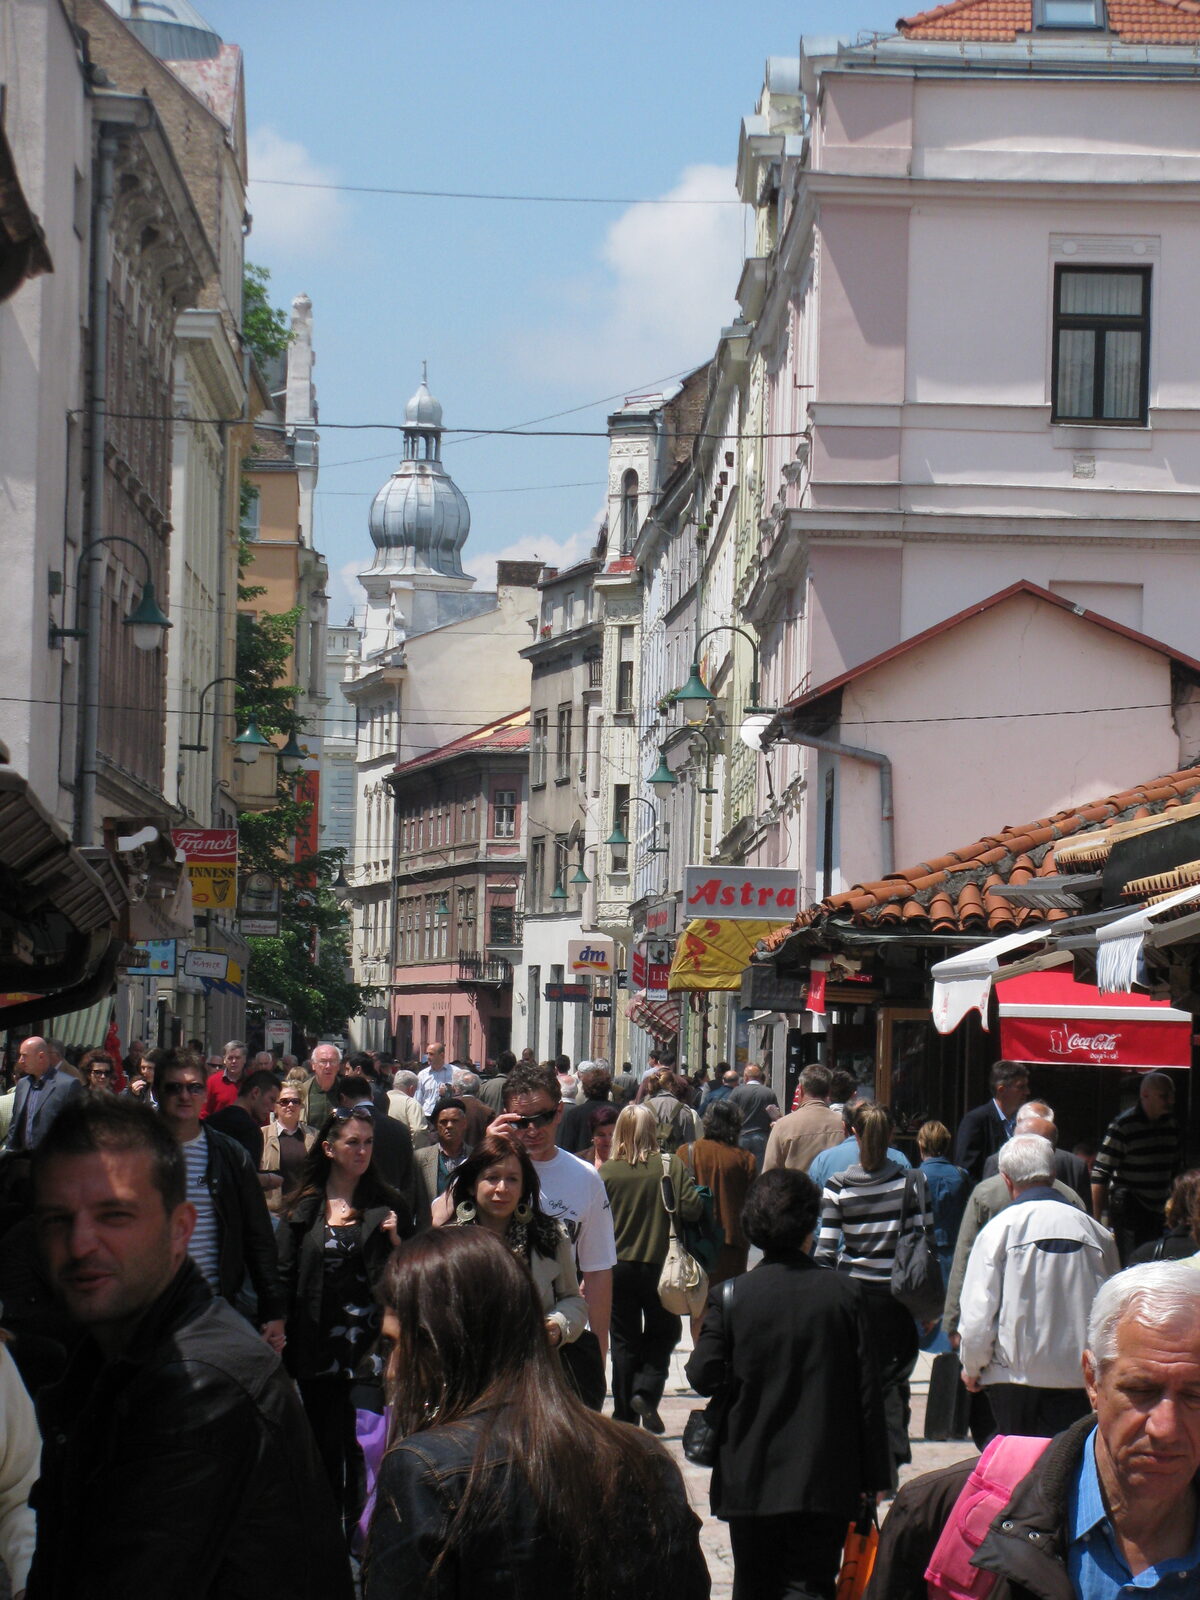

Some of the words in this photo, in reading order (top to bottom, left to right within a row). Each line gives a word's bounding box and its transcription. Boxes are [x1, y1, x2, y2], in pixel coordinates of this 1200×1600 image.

[177, 832, 237, 850] Franck
[189, 867, 235, 878] INNESS
[688, 879, 797, 907] Astra
[579, 945, 605, 961] dm
